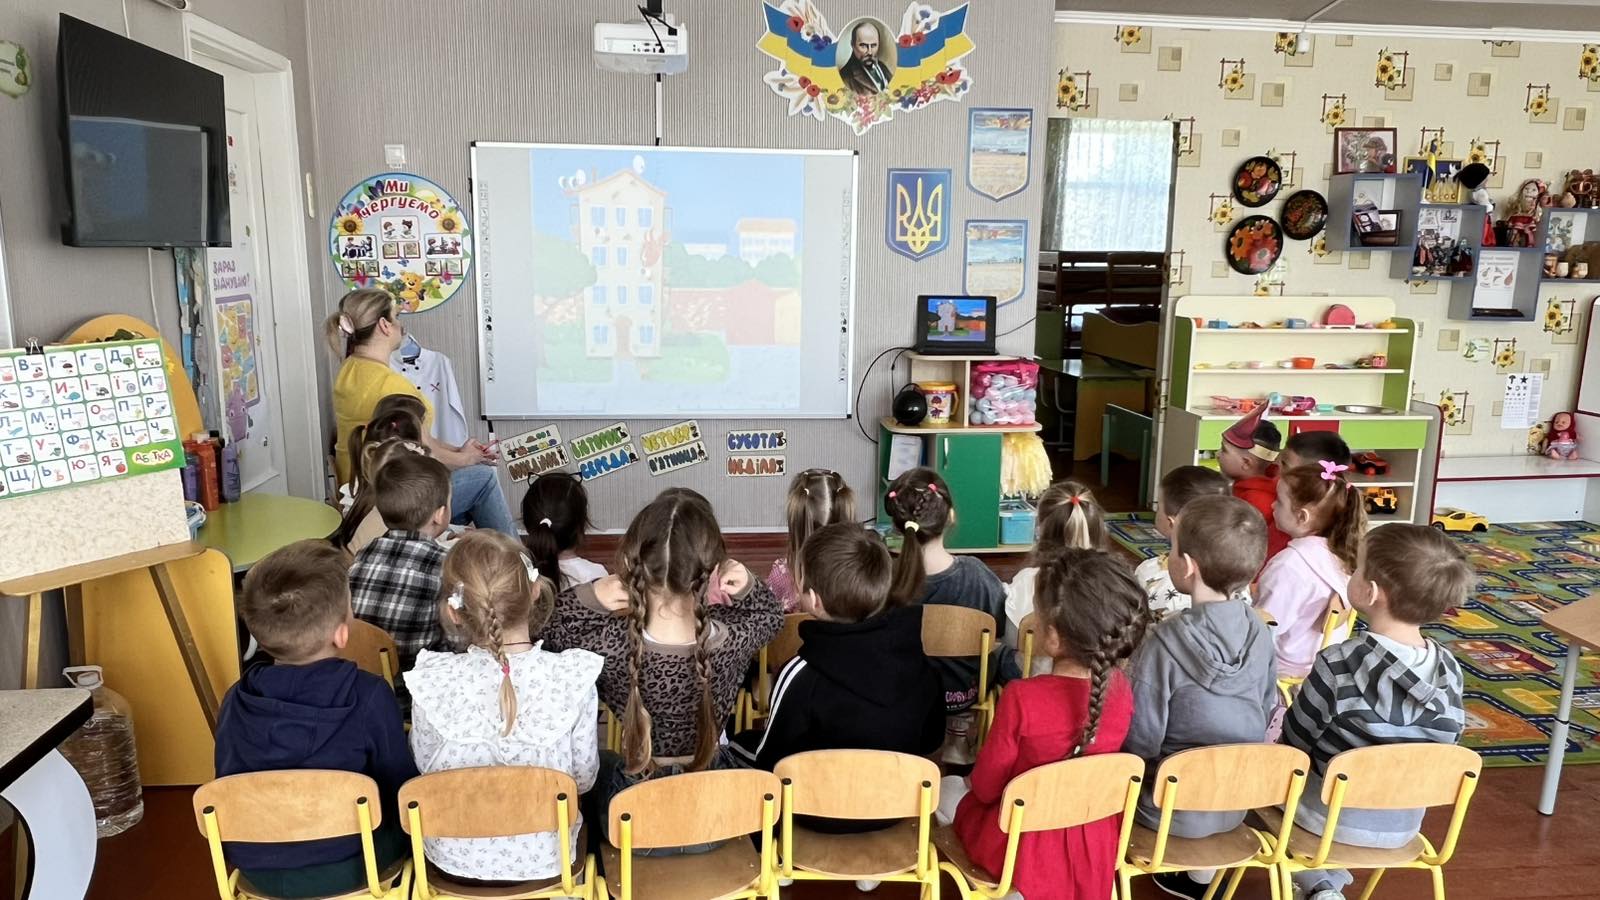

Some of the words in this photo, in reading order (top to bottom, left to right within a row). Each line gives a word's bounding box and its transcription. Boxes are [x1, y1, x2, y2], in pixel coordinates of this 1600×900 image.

[385, 180, 408, 192] Ми
[213, 260, 236, 274] ЗАРАЗ
[18, 359, 29, 371] В
[49, 356, 56, 368] Г
[80, 353, 87, 366] Ґ
[110, 349, 122, 364] Д
[136, 347, 144, 359] Е
[24, 386, 34, 398] З
[55, 382, 68, 394] И
[113, 375, 120, 390] Ї
[141, 372, 153, 386] Й
[30, 411, 45, 424] М
[60, 407, 72, 420] Н
[90, 404, 101, 415] О
[118, 400, 129, 412] П
[145, 397, 154, 408] Р
[3, 443, 12, 455] Т
[35, 438, 45, 450] У
[66, 434, 80, 445] Ф
[95, 430, 107, 442] Х
[123, 425, 135, 436] Ц
[150, 421, 160, 431] Ч
[728, 432, 777, 450] СУБОТА
[10, 468, 31, 482] Щ
[41, 465, 52, 477] Ь
[71, 459, 86, 470] Ю
[101, 455, 111, 466] Я
